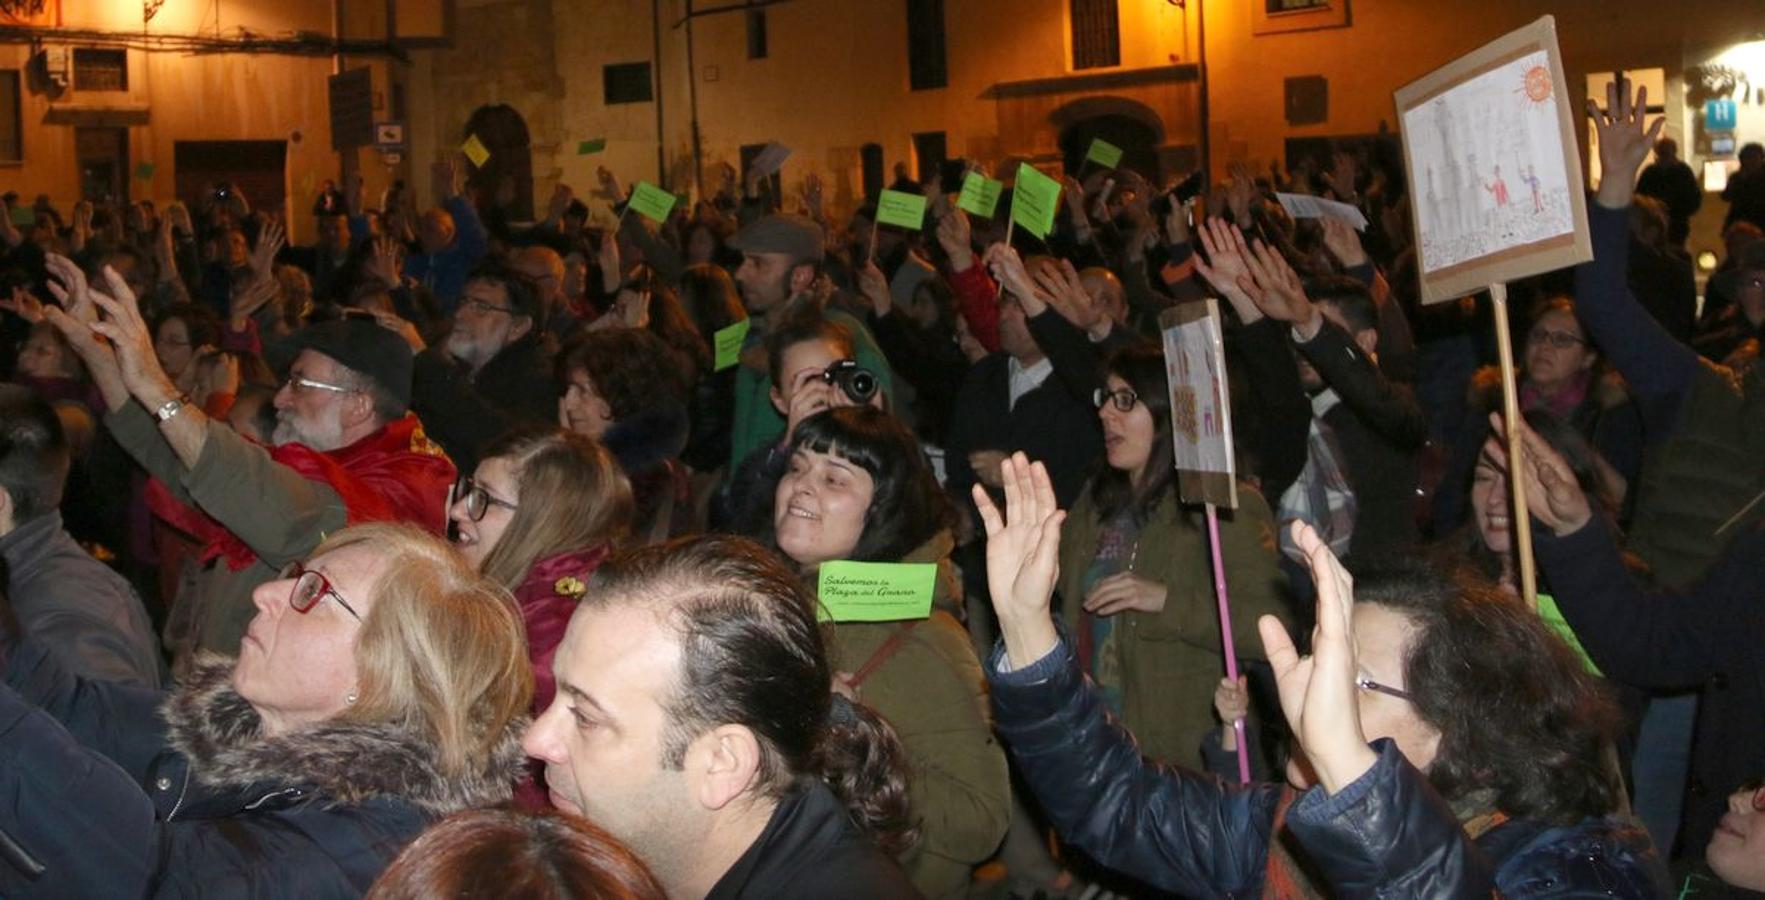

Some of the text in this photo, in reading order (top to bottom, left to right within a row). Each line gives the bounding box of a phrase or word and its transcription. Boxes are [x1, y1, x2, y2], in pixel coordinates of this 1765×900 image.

[824, 575, 878, 586] Salvemos
[824, 586, 916, 598] Plaza del Grano
